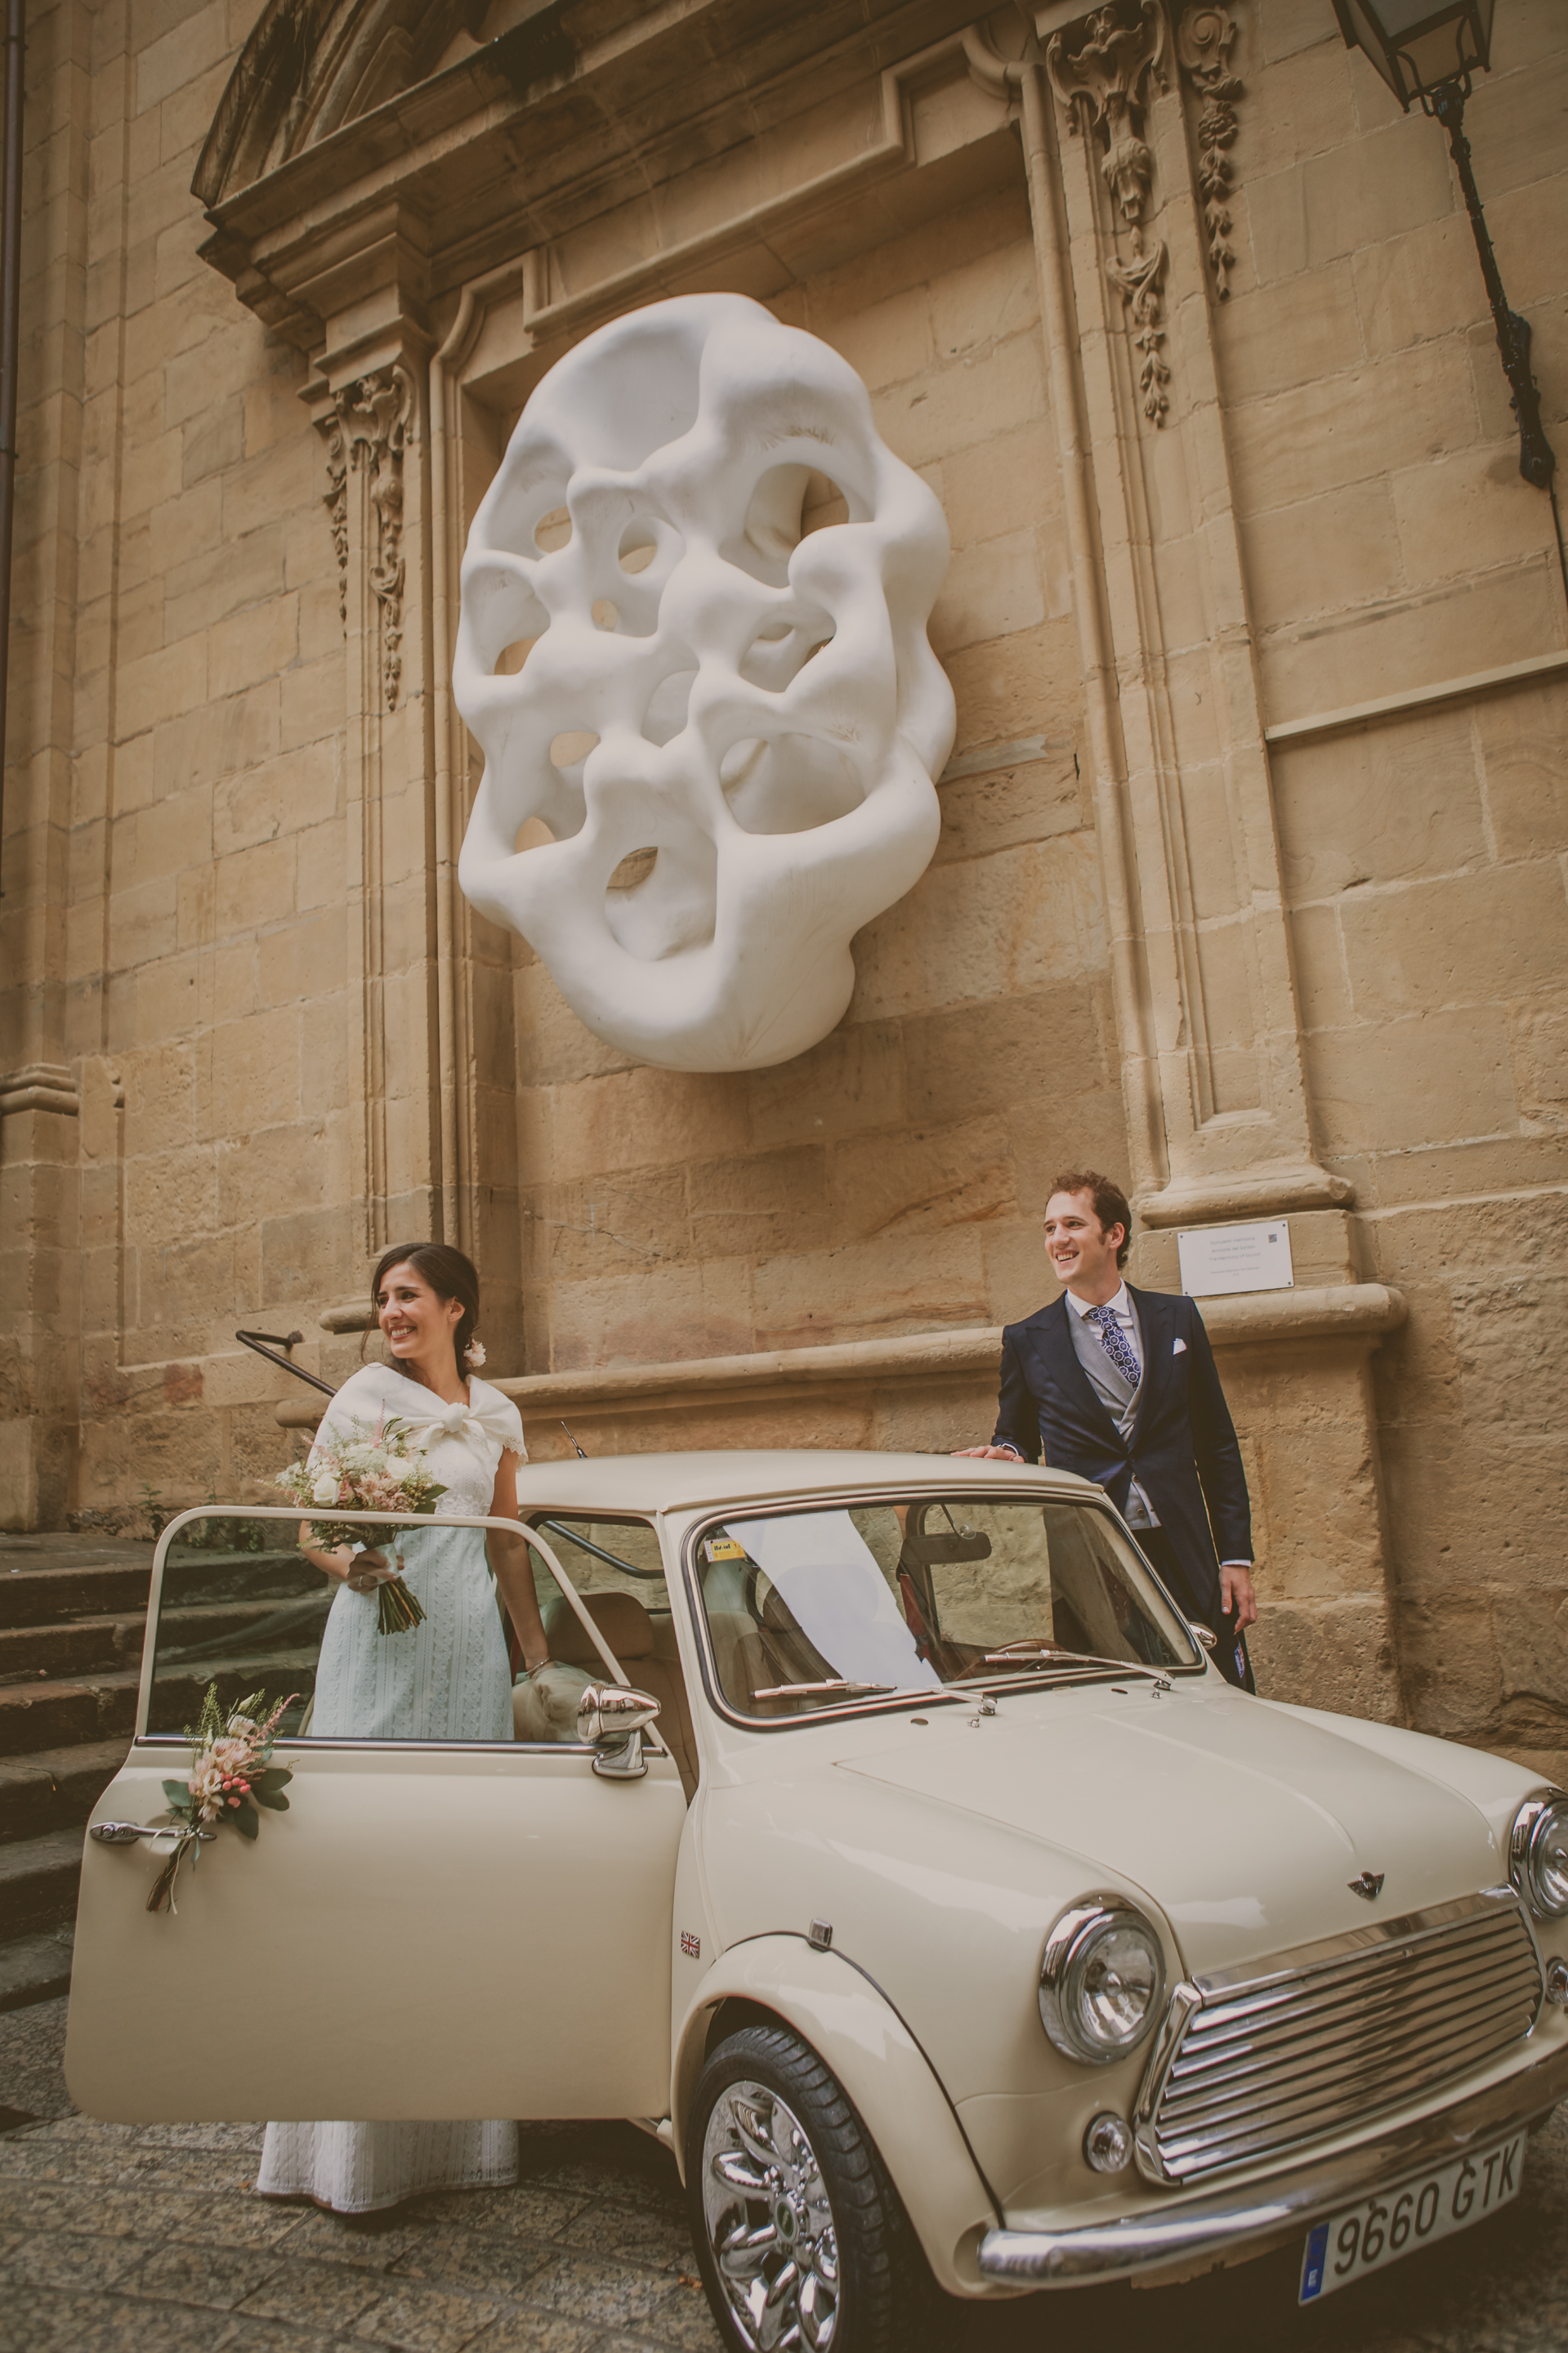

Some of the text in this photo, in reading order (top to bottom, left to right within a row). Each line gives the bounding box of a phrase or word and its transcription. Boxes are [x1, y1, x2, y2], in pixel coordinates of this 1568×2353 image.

[1334, 2138, 1520, 2275] 9660 GTK
[1308, 2268, 1318, 2287] E
